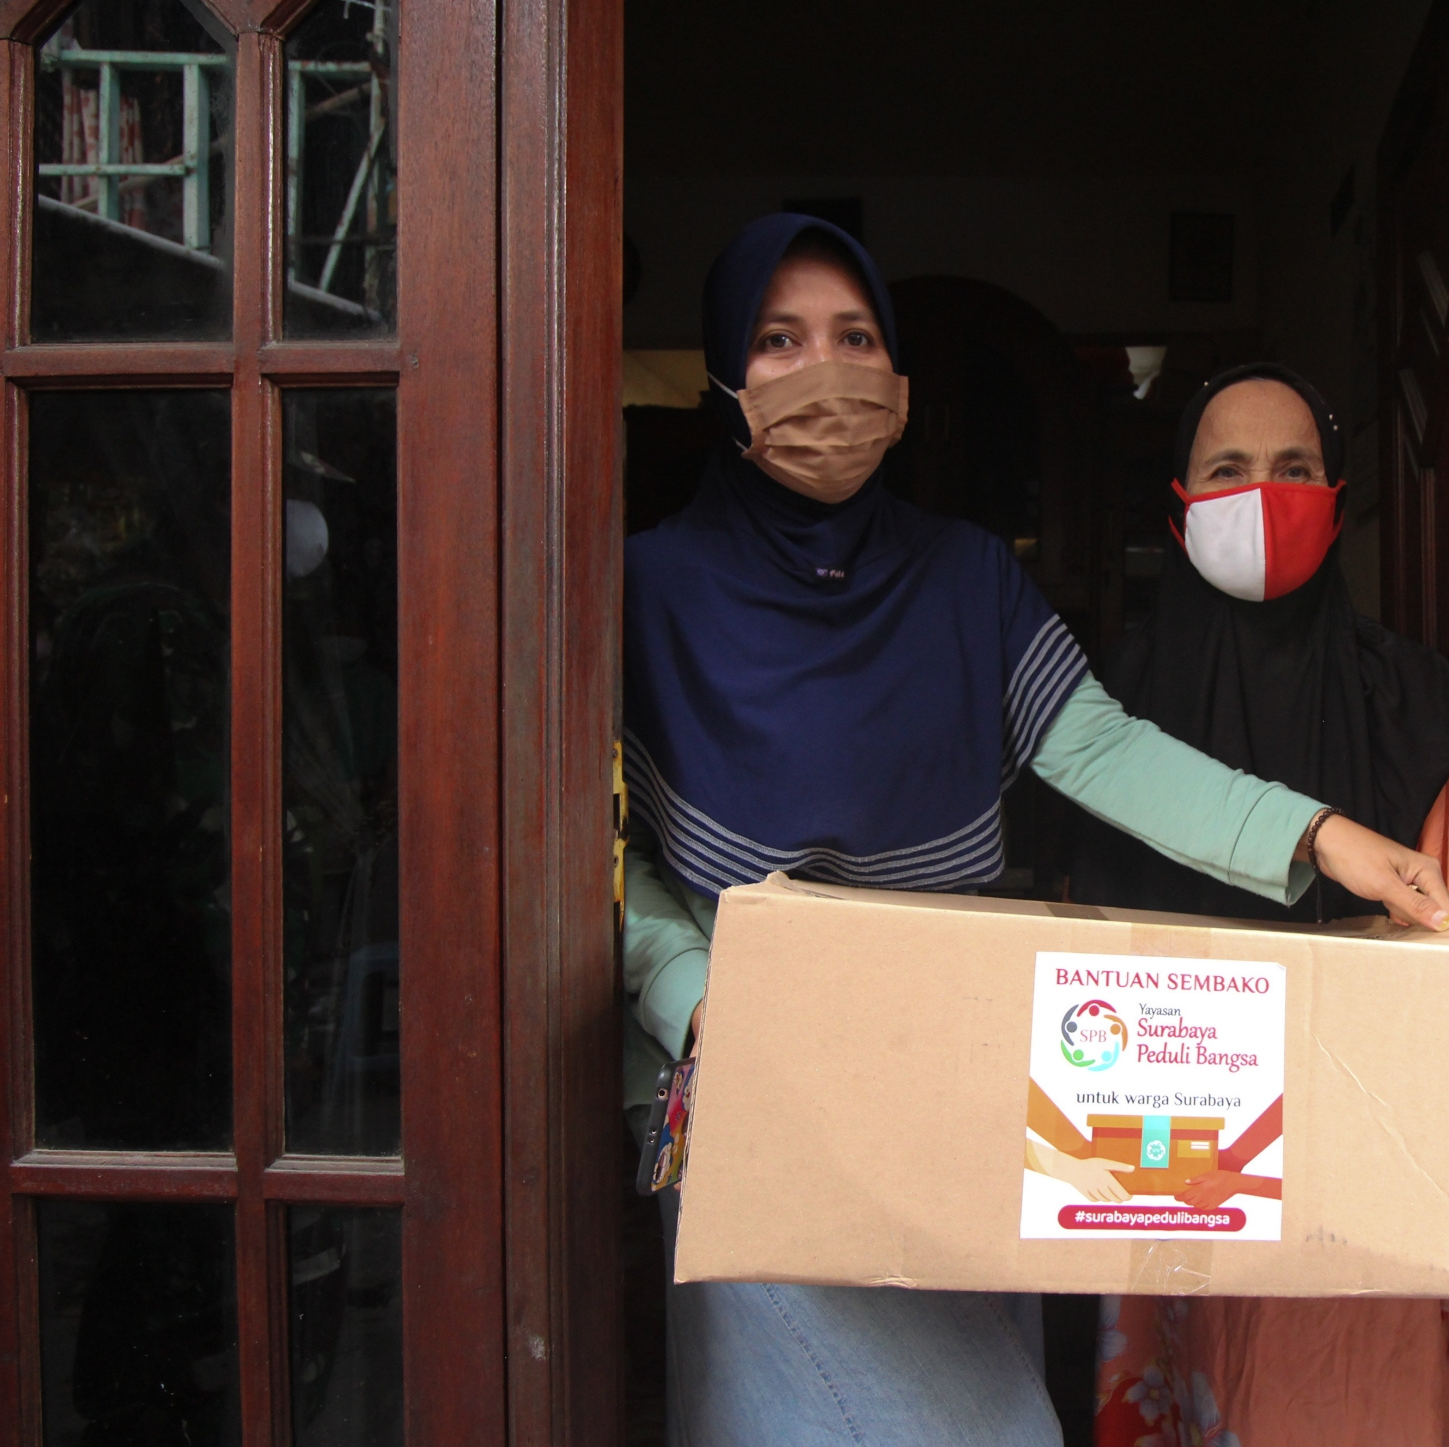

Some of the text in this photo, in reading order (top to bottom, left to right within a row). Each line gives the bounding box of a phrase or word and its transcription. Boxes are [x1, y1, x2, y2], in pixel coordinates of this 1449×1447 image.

[1056, 968, 1270, 994] BANTUAN SEMBAKO
[1139, 1003, 1181, 1019] Yayasan
[1080, 1030, 1106, 1043] SPB
[1137, 1017, 1218, 1045] Surabaya
[1137, 1042, 1259, 1073] Peduli Bangsa
[1076, 1091, 1241, 1110] untuk warga Surabaya
[1075, 1211, 1230, 1227] #surabayapedulibangsa
